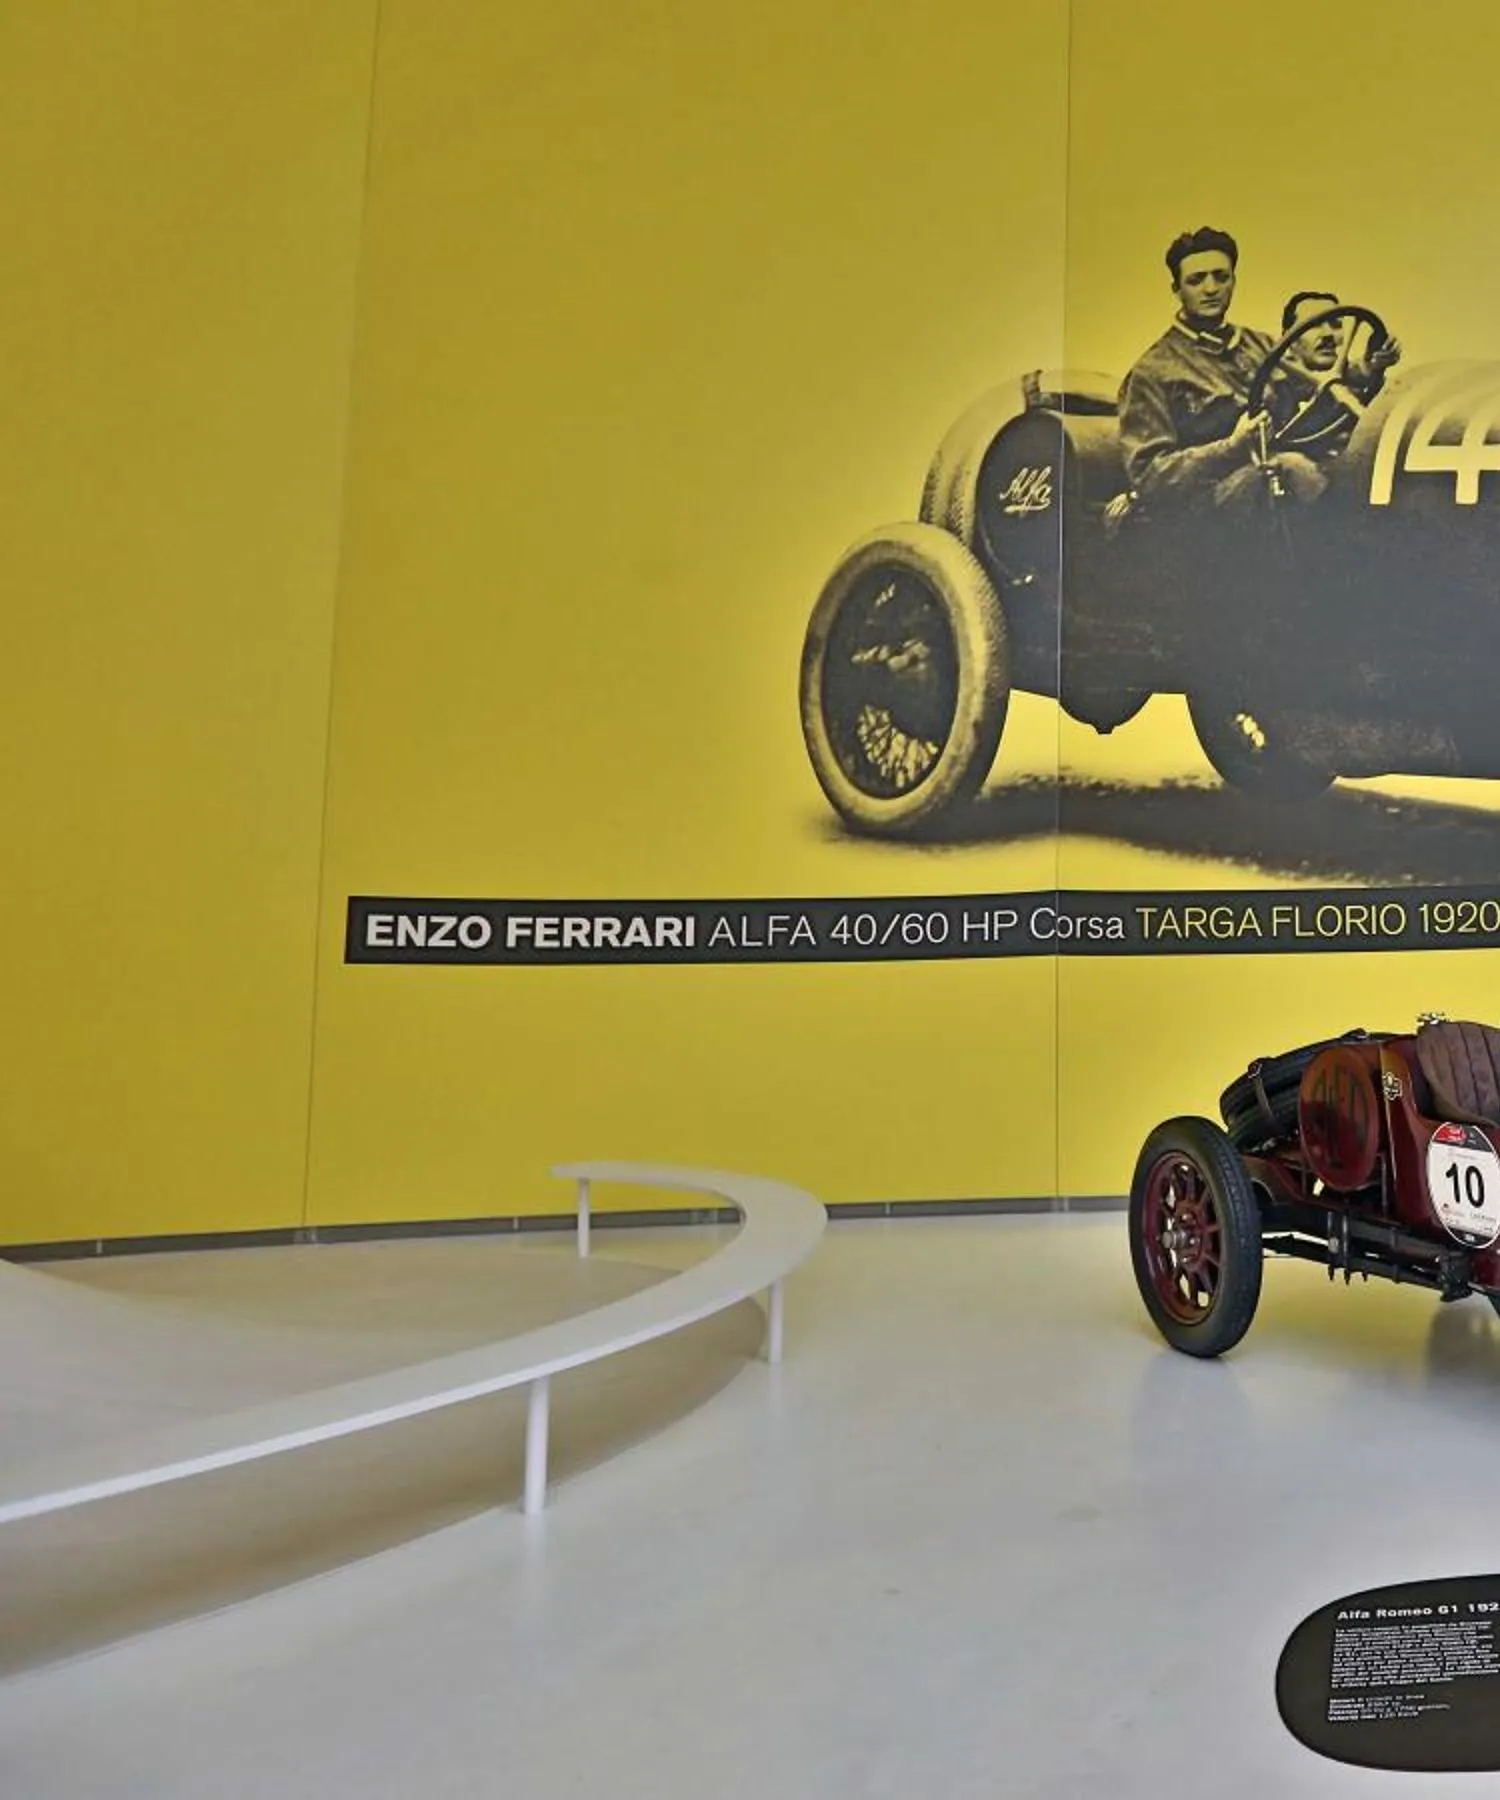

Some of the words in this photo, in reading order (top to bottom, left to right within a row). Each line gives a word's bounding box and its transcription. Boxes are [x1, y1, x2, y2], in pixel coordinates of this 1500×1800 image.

[365, 914, 492, 948] ENZO
[505, 916, 695, 948] FERRARI
[708, 914, 817, 947] ALFA
[830, 912, 949, 945] 40/60
[962, 909, 1018, 942] HP
[1029, 907, 1125, 940] Corsa
[1135, 906, 1263, 940] TARGA
[1272, 903, 1406, 937] FLORIO
[1418, 900, 1500, 934] 1920
[1445, 1162, 1485, 1208] 10
[1337, 1609, 1370, 1620] Alfa
[1376, 1606, 1433, 1618] Romeo
